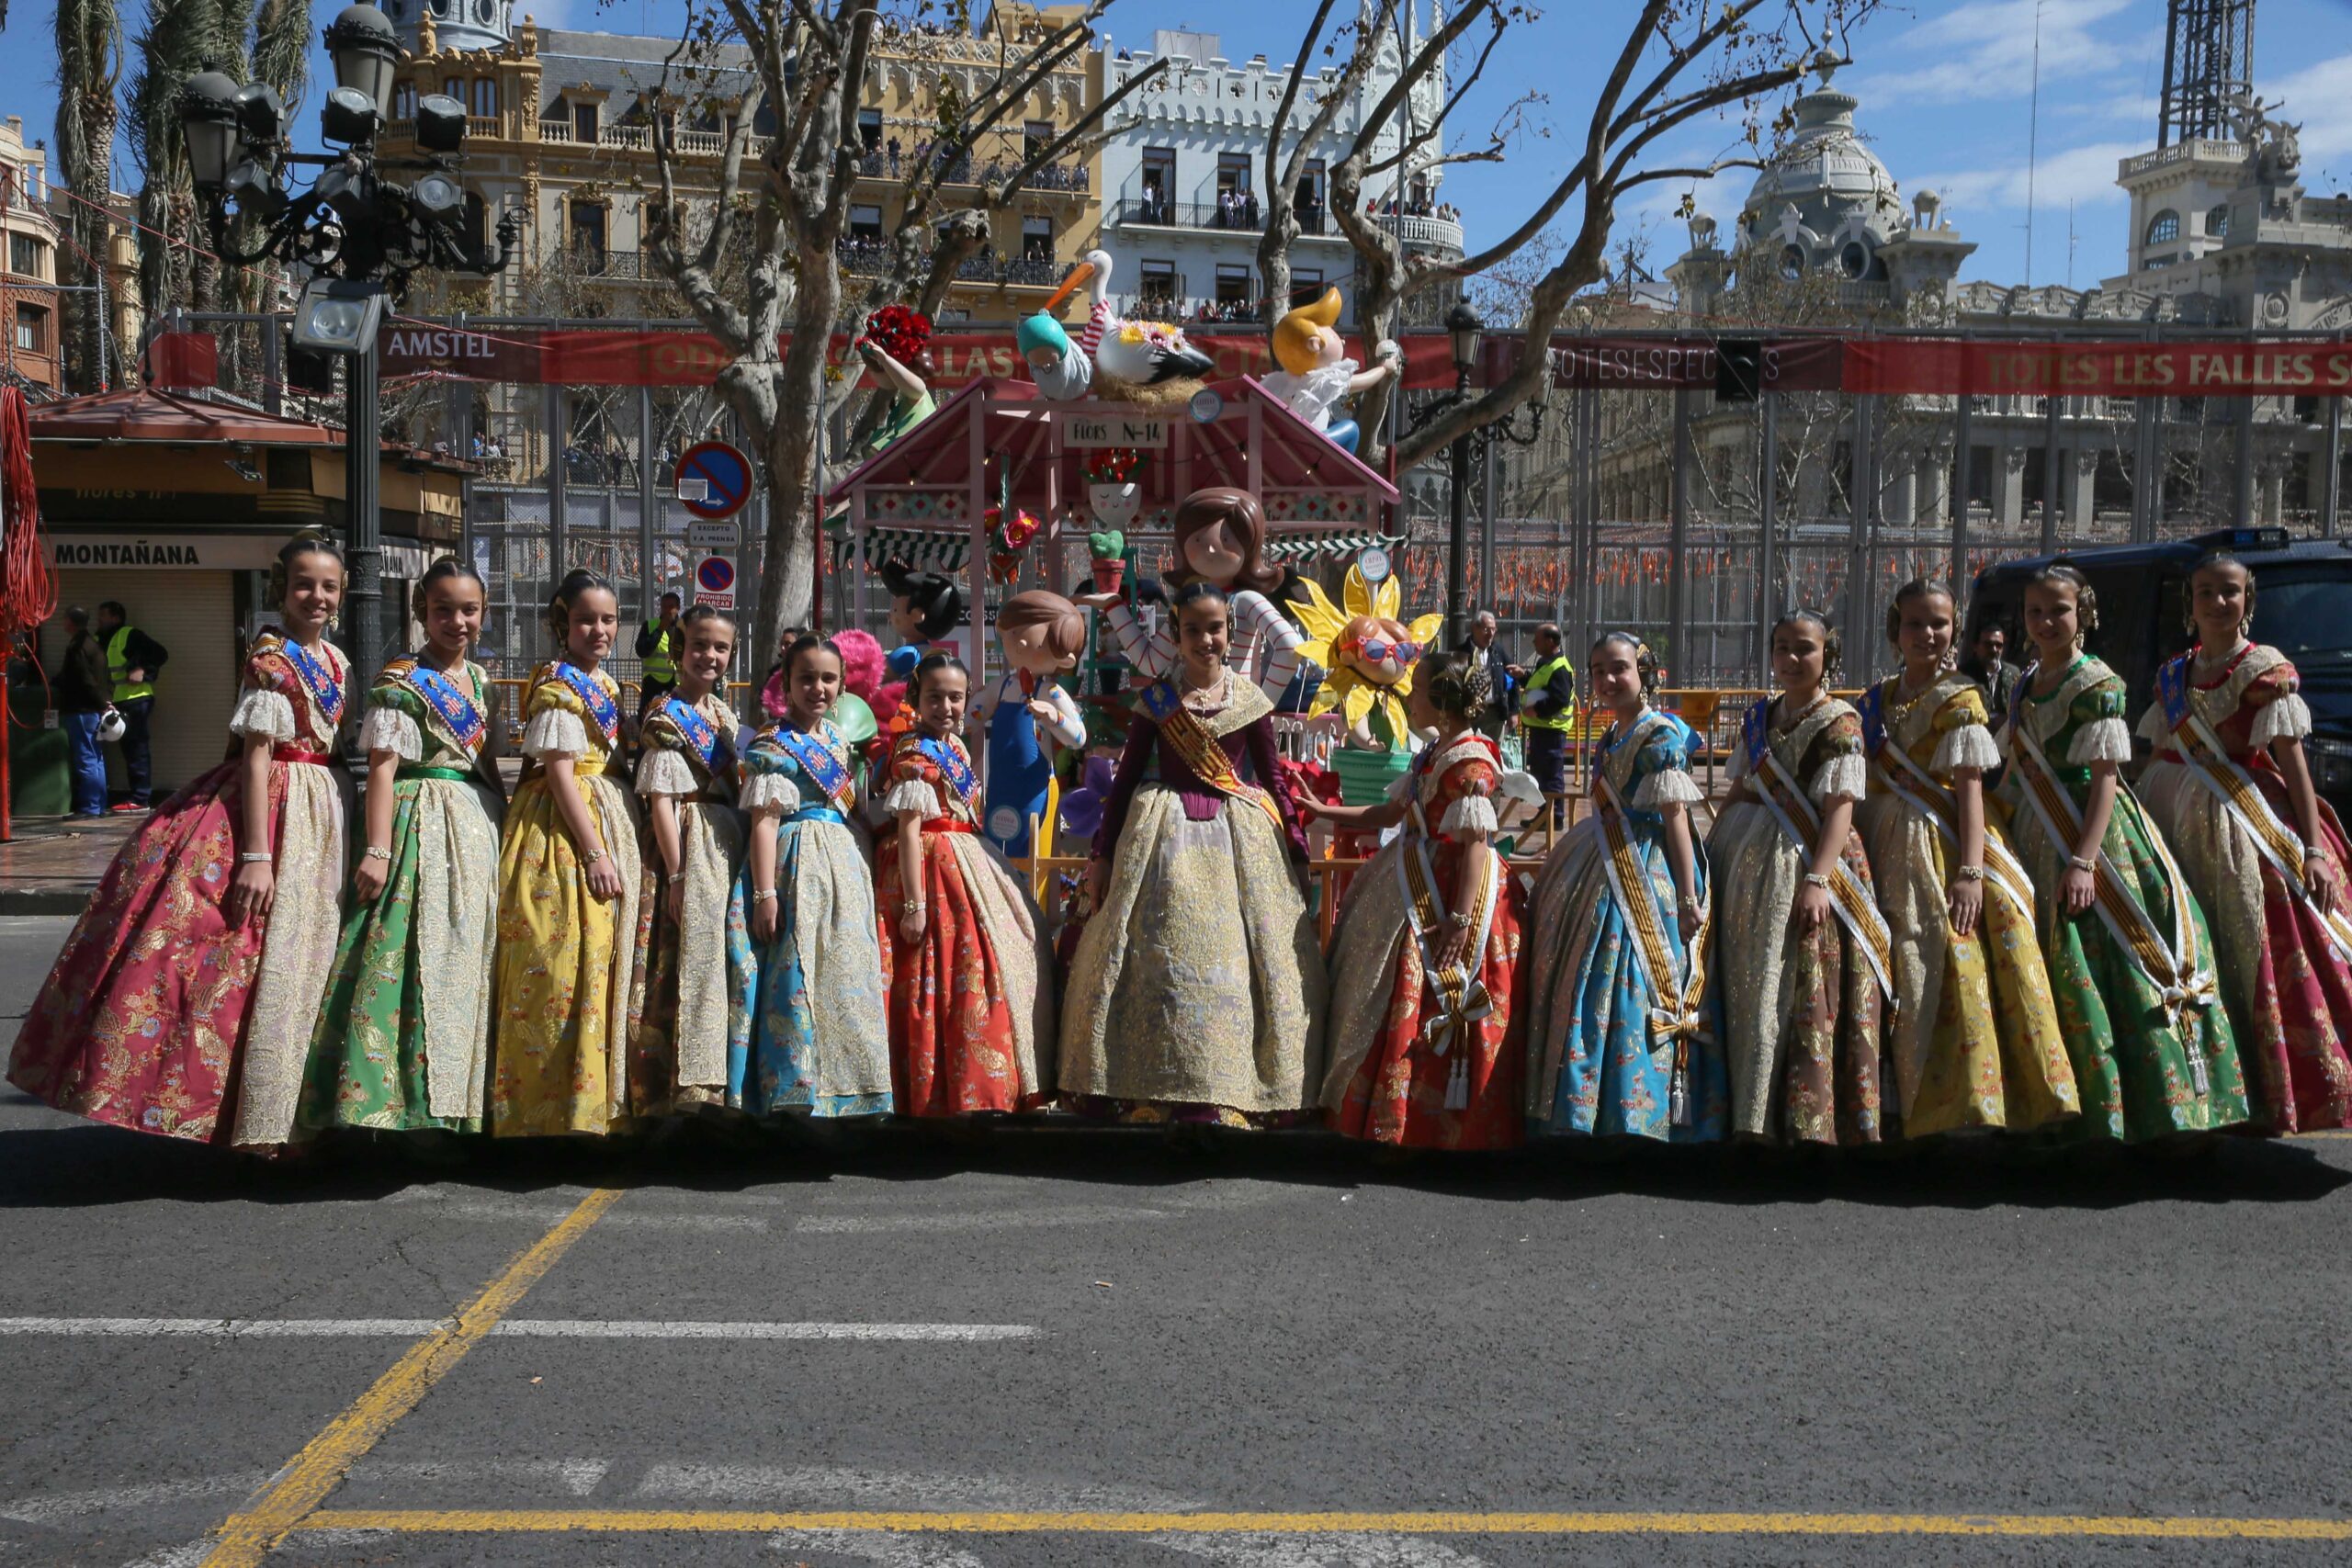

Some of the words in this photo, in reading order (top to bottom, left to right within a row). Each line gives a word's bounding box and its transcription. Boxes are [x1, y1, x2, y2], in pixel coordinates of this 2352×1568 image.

[387, 331, 496, 358] AMSTEL
[1985, 353, 2100, 385] TOTES
[2113, 354, 2176, 385] LES
[2188, 354, 2315, 386] FALLES
[55, 539, 199, 565] MONTAÑANA
[696, 593, 732, 602] PROHIBIDO
